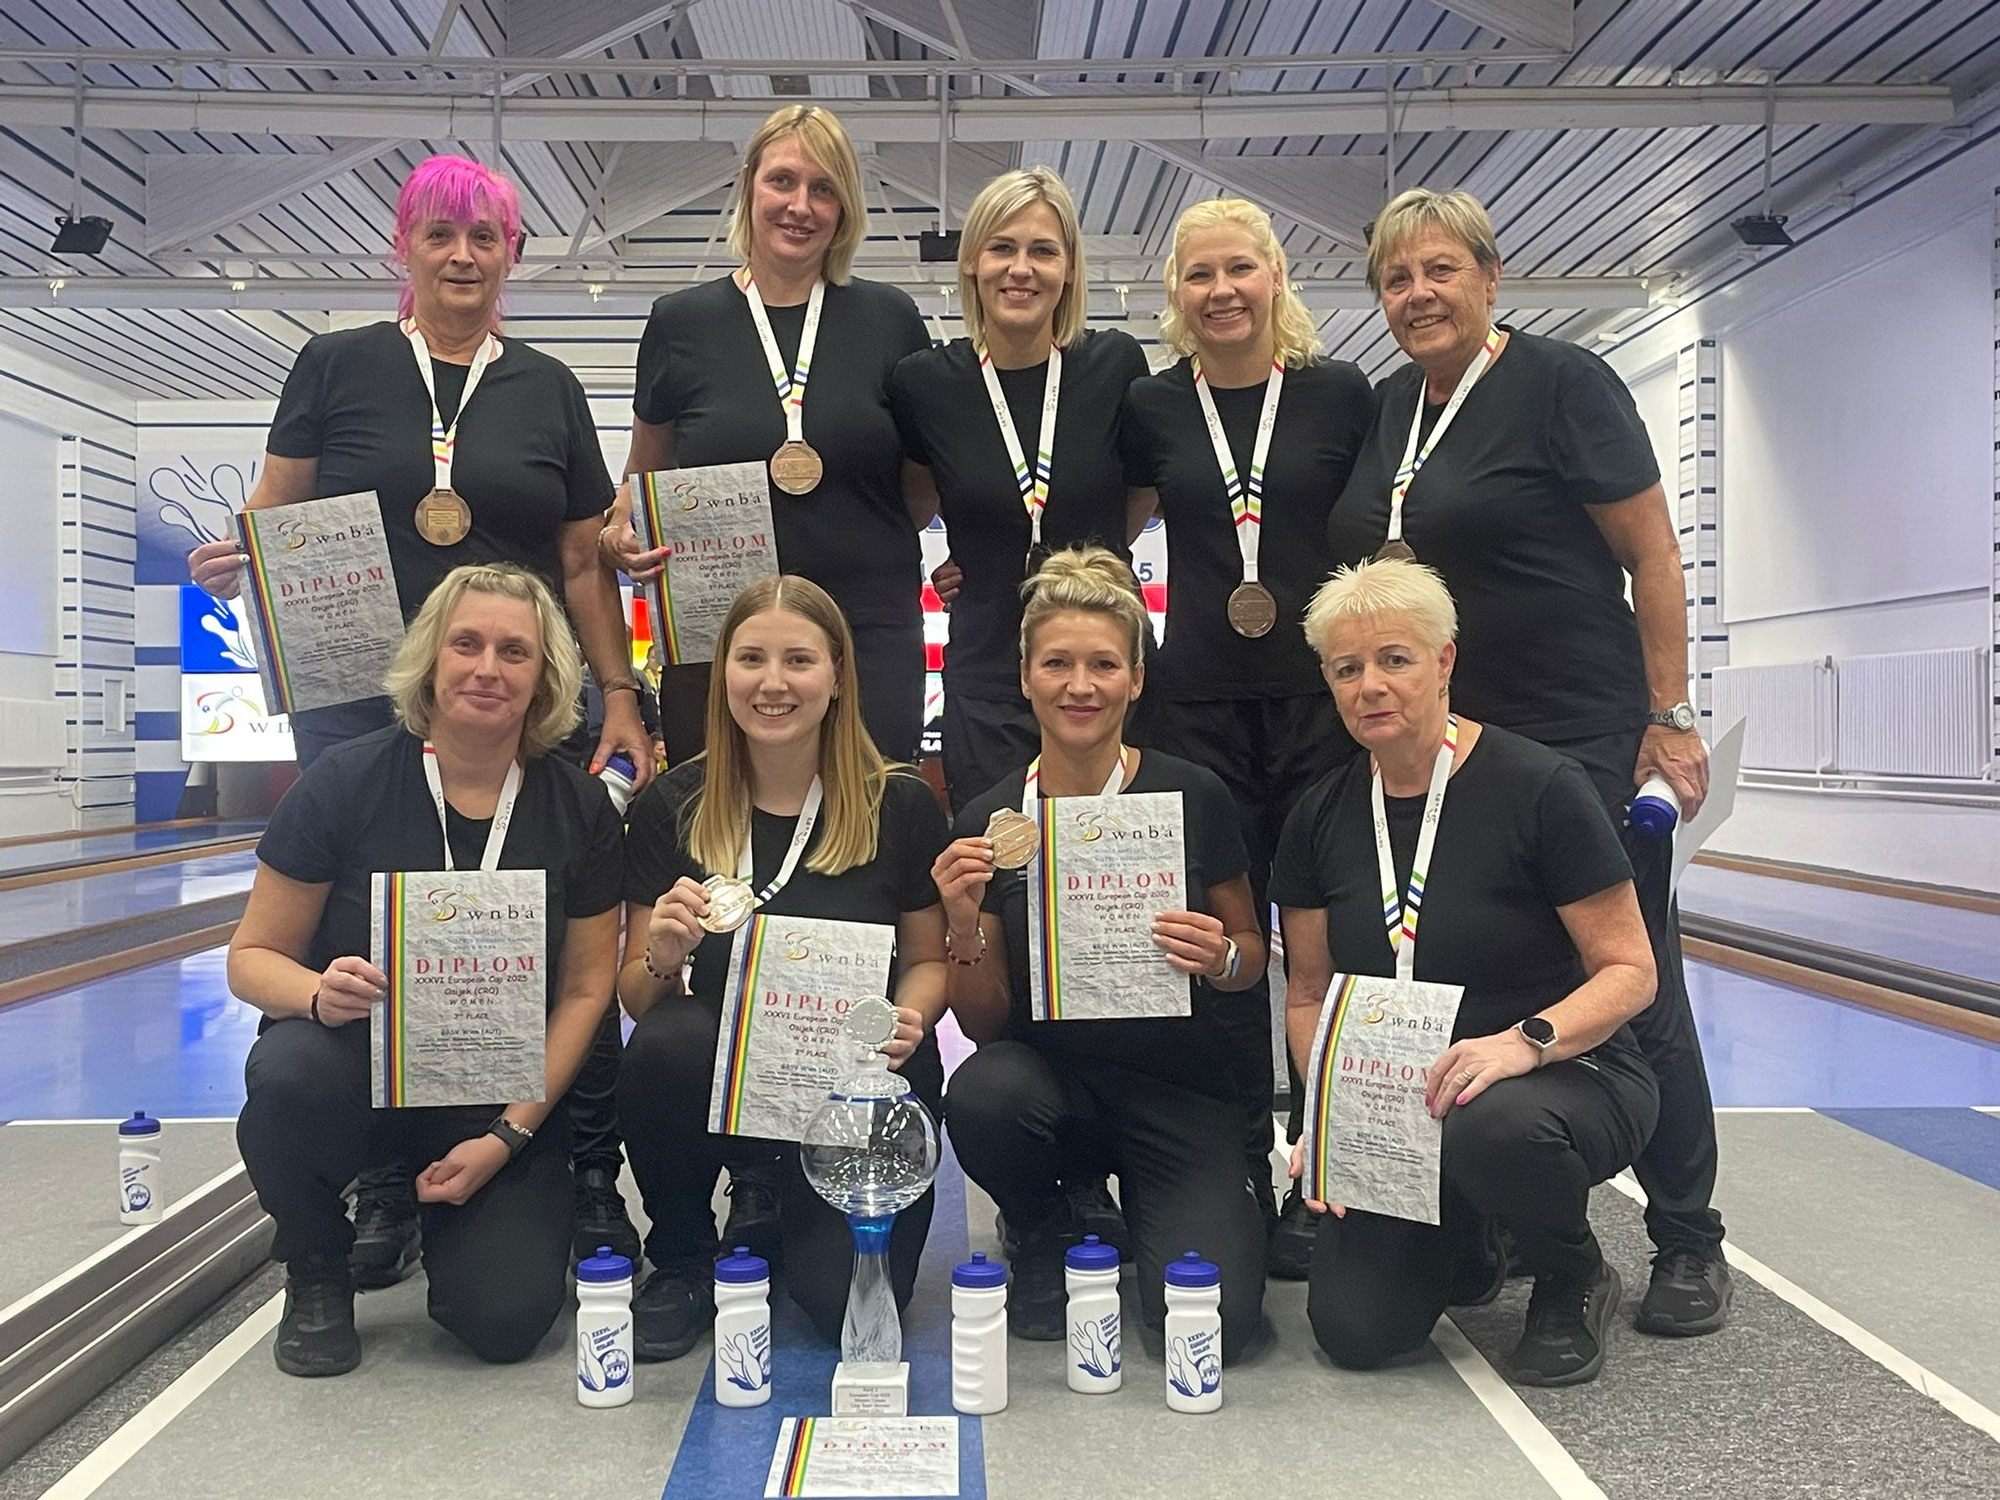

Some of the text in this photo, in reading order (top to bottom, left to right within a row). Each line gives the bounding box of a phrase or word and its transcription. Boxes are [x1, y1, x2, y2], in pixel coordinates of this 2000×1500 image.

[707, 493, 761, 508] wnba
[316, 525, 374, 544] wnba
[674, 534, 766, 554] DIPLOM
[1139, 562, 1153, 583] 5
[281, 567, 384, 597] DIPLOM
[1112, 825, 1173, 840] wnba
[1067, 872, 1176, 890] DIPLOM
[468, 905, 535, 920] wnba
[416, 956, 536, 974] DIPLOM
[818, 952, 879, 968] wnba
[448, 975, 486, 985] European
[489, 976, 503, 984] Cup
[765, 991, 850, 1014] DIPLO
[1392, 1016, 1443, 1032] wnba
